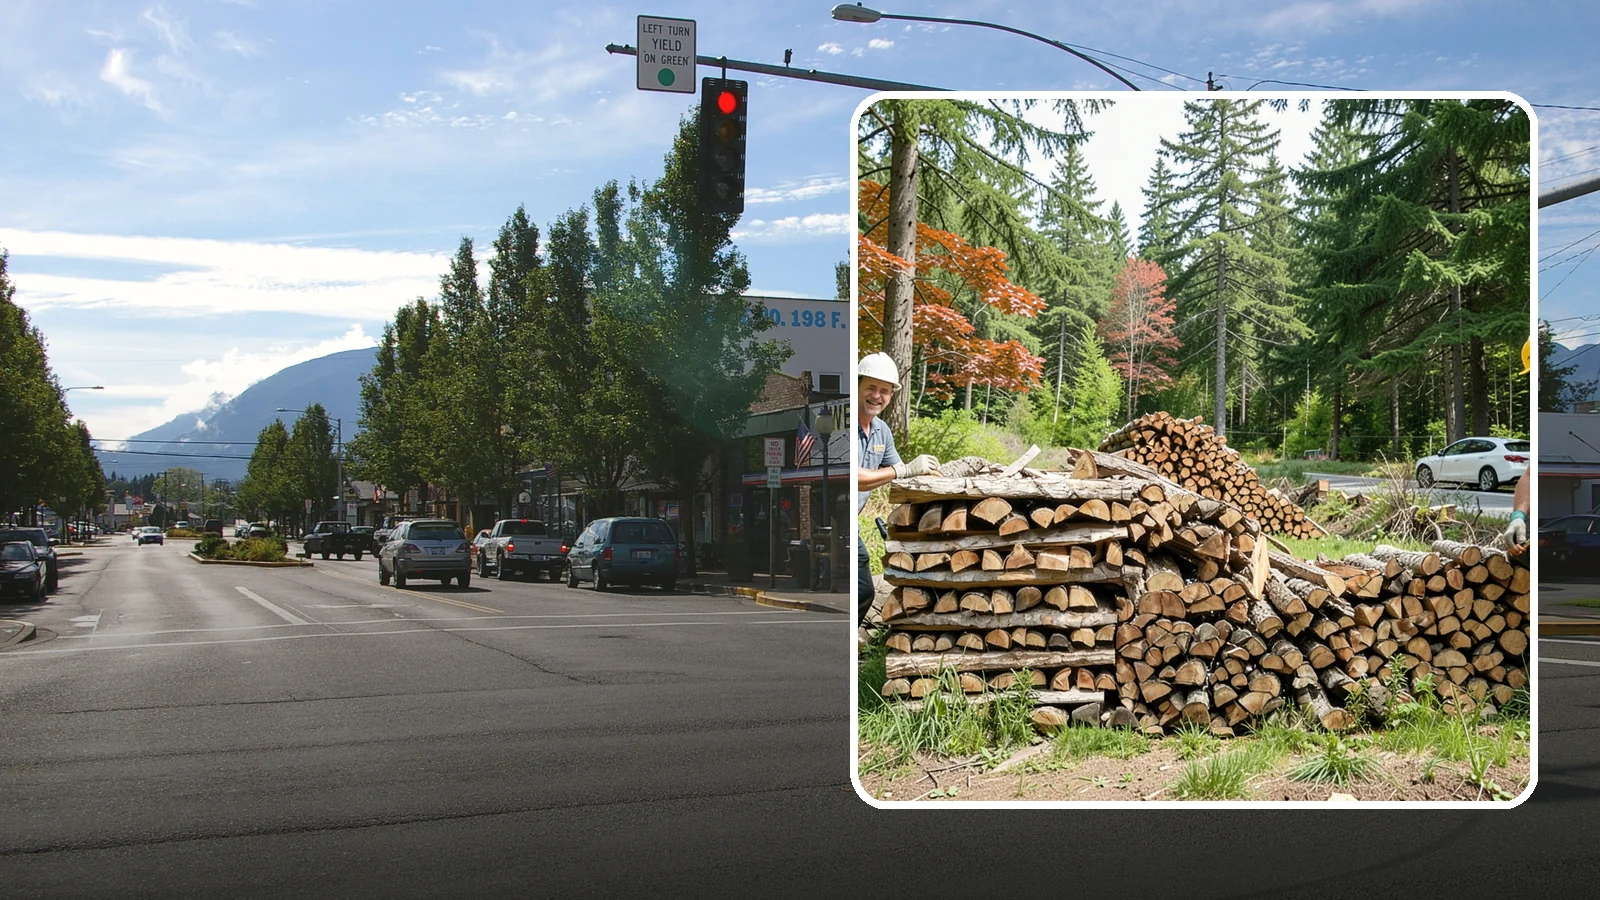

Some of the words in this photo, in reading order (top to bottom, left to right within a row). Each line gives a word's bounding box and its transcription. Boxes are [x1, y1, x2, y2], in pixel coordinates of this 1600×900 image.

[643, 24, 663, 34] LEFT
[668, 26, 690, 36] TURN
[652, 38, 682, 52] YIELD
[644, 53, 656, 64] ON
[661, 55, 689, 66] GREEN
[791, 309, 826, 328] 198
[831, 311, 847, 329] F.
